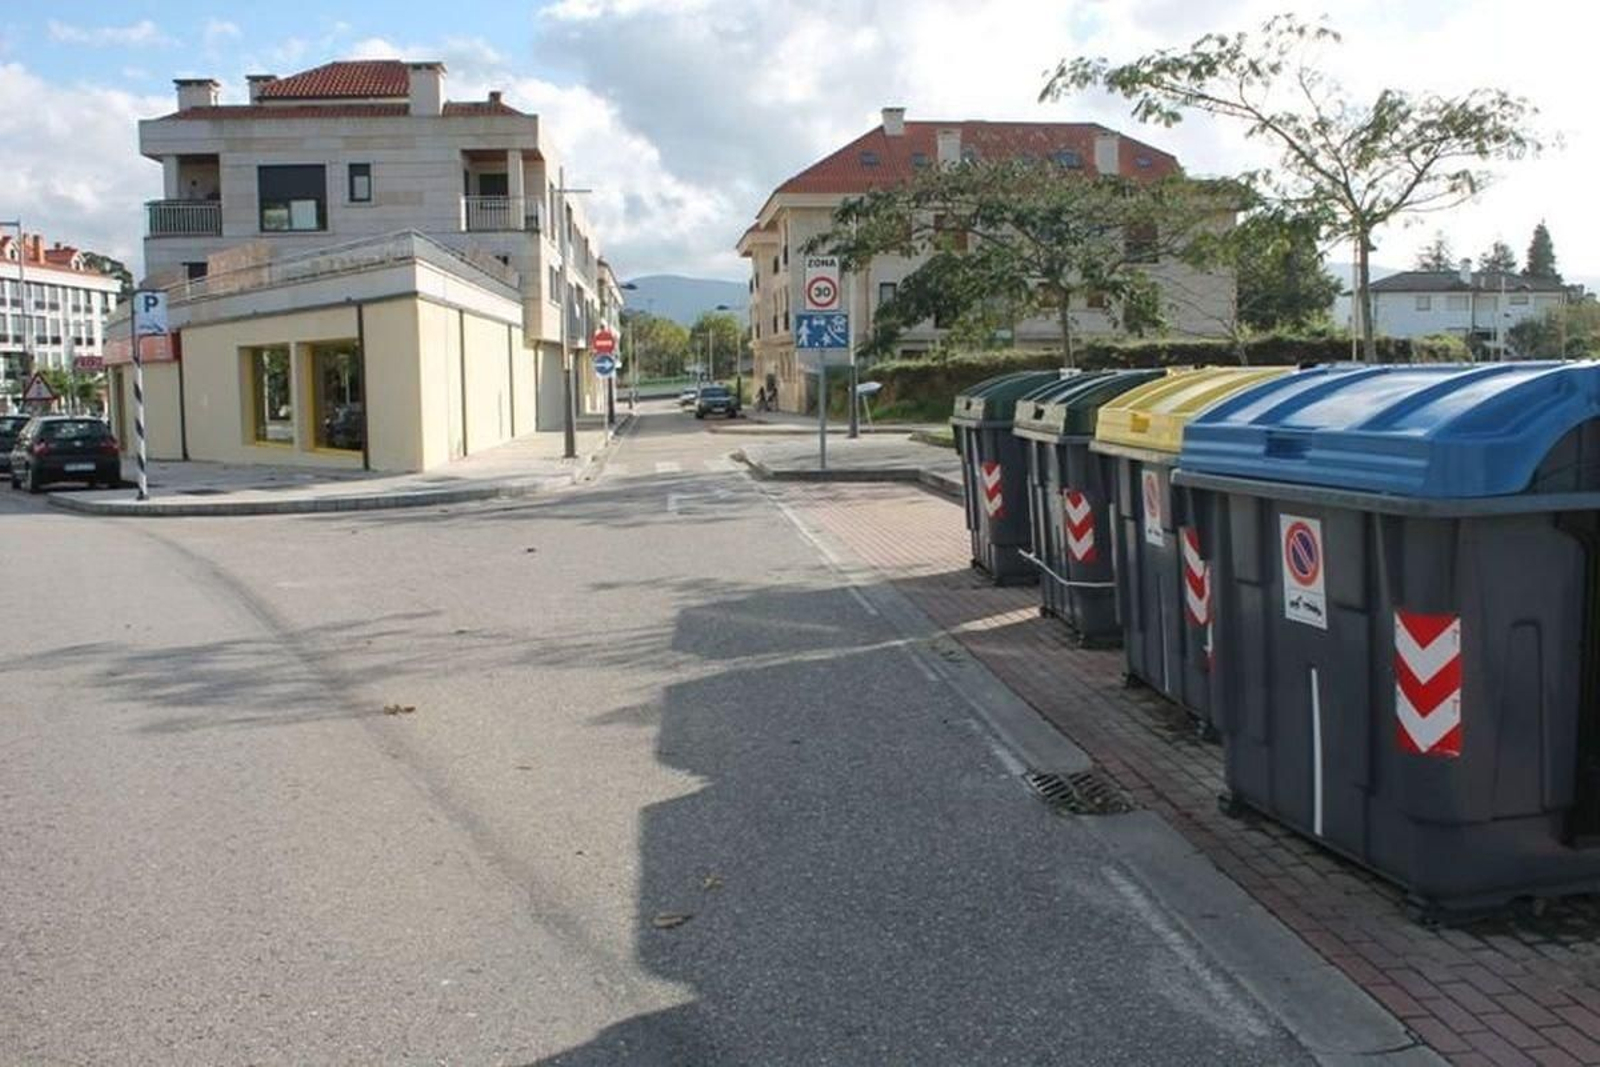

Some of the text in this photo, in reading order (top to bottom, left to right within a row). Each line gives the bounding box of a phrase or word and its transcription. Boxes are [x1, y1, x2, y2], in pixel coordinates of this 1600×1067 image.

[807, 258, 837, 268] ZONA
[814, 286, 831, 298] 30
[144, 294, 159, 313] P
